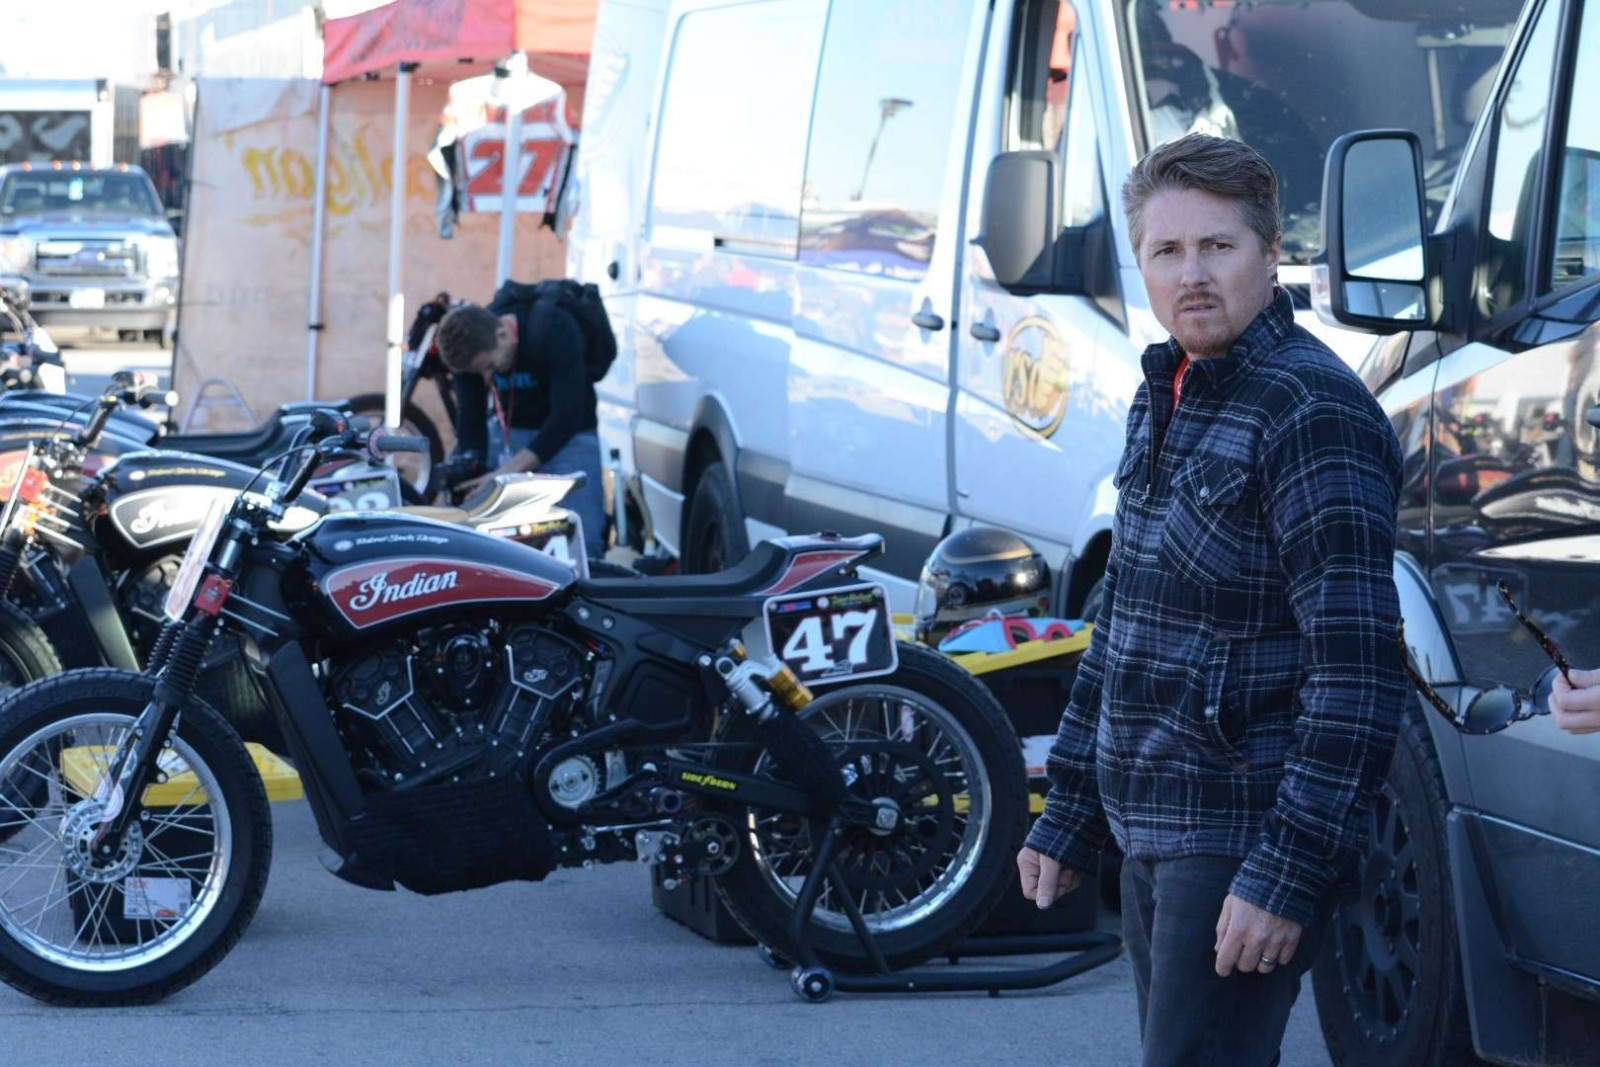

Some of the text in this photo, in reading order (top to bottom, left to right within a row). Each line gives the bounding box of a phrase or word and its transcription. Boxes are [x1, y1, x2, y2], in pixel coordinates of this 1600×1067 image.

[466, 139, 561, 196] 27
[349, 570, 459, 611] Indian
[782, 608, 878, 673] 47
